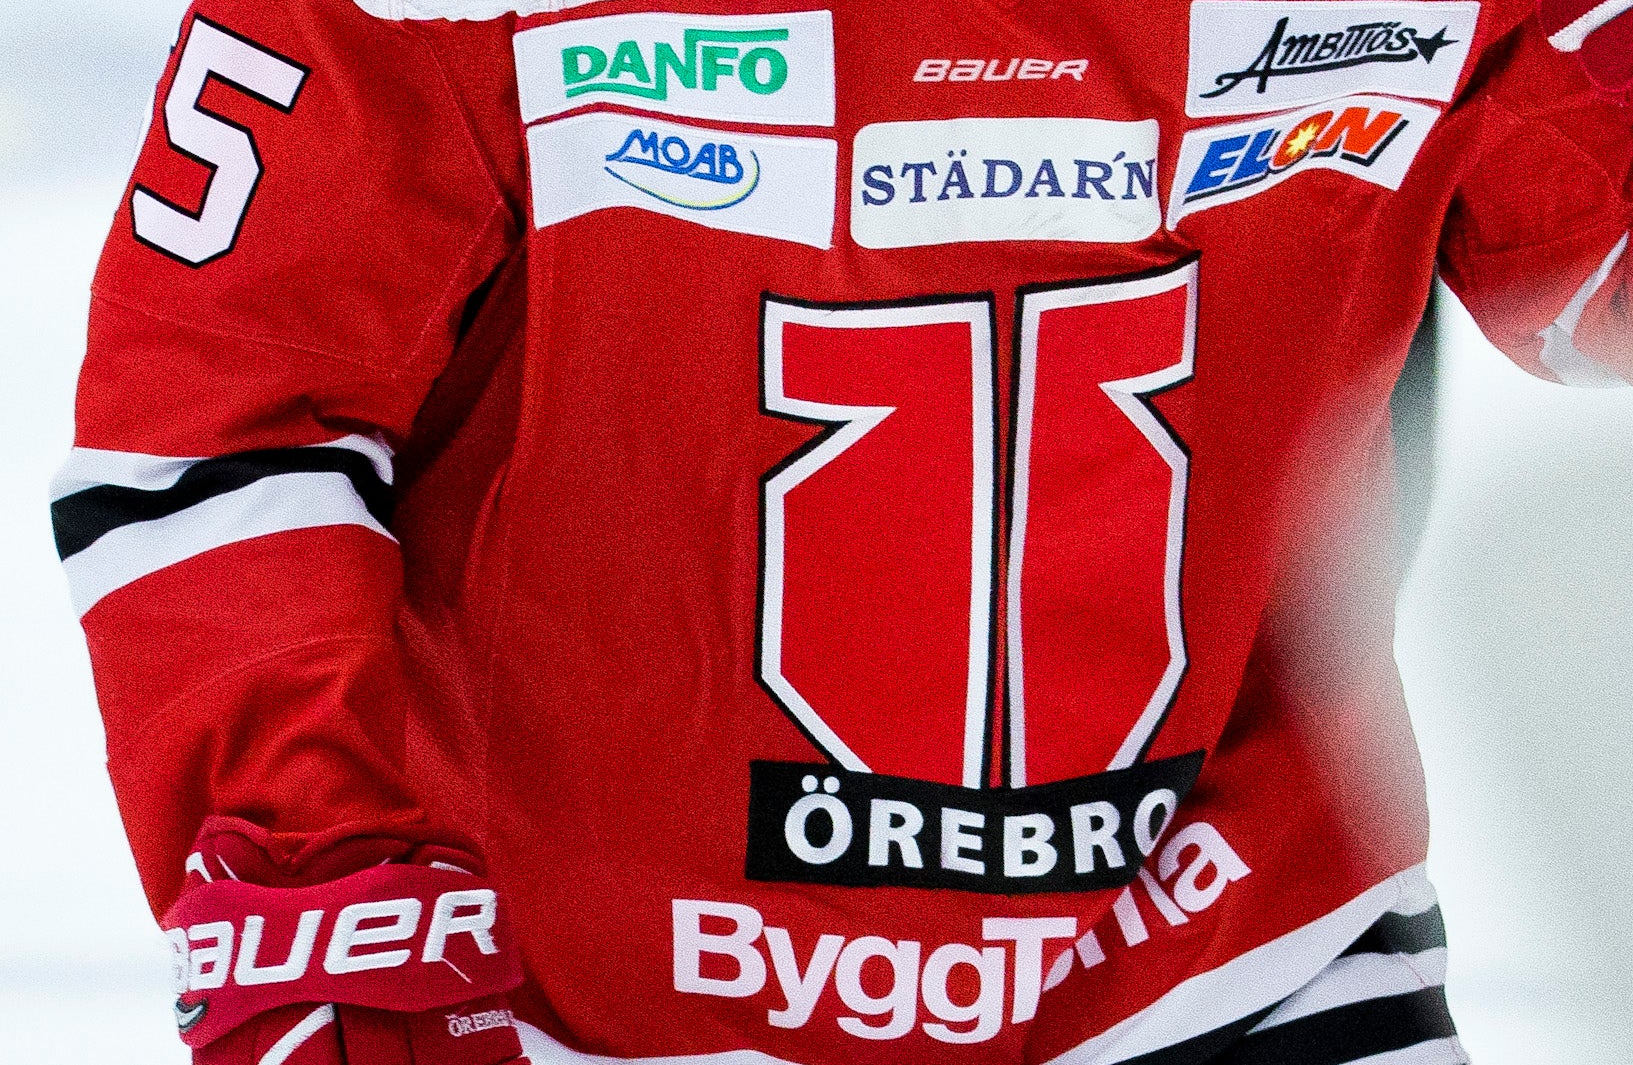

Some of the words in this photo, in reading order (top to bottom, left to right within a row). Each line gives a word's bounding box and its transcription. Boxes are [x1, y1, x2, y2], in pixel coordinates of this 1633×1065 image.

[561, 28, 789, 101] DANFO
[912, 57, 1090, 83] BAUER
[605, 129, 744, 185] MOAB
[1183, 106, 1408, 204] ELON
[784, 775, 1176, 878] ÖREBRO
[671, 821, 1252, 1044] ByggTa
